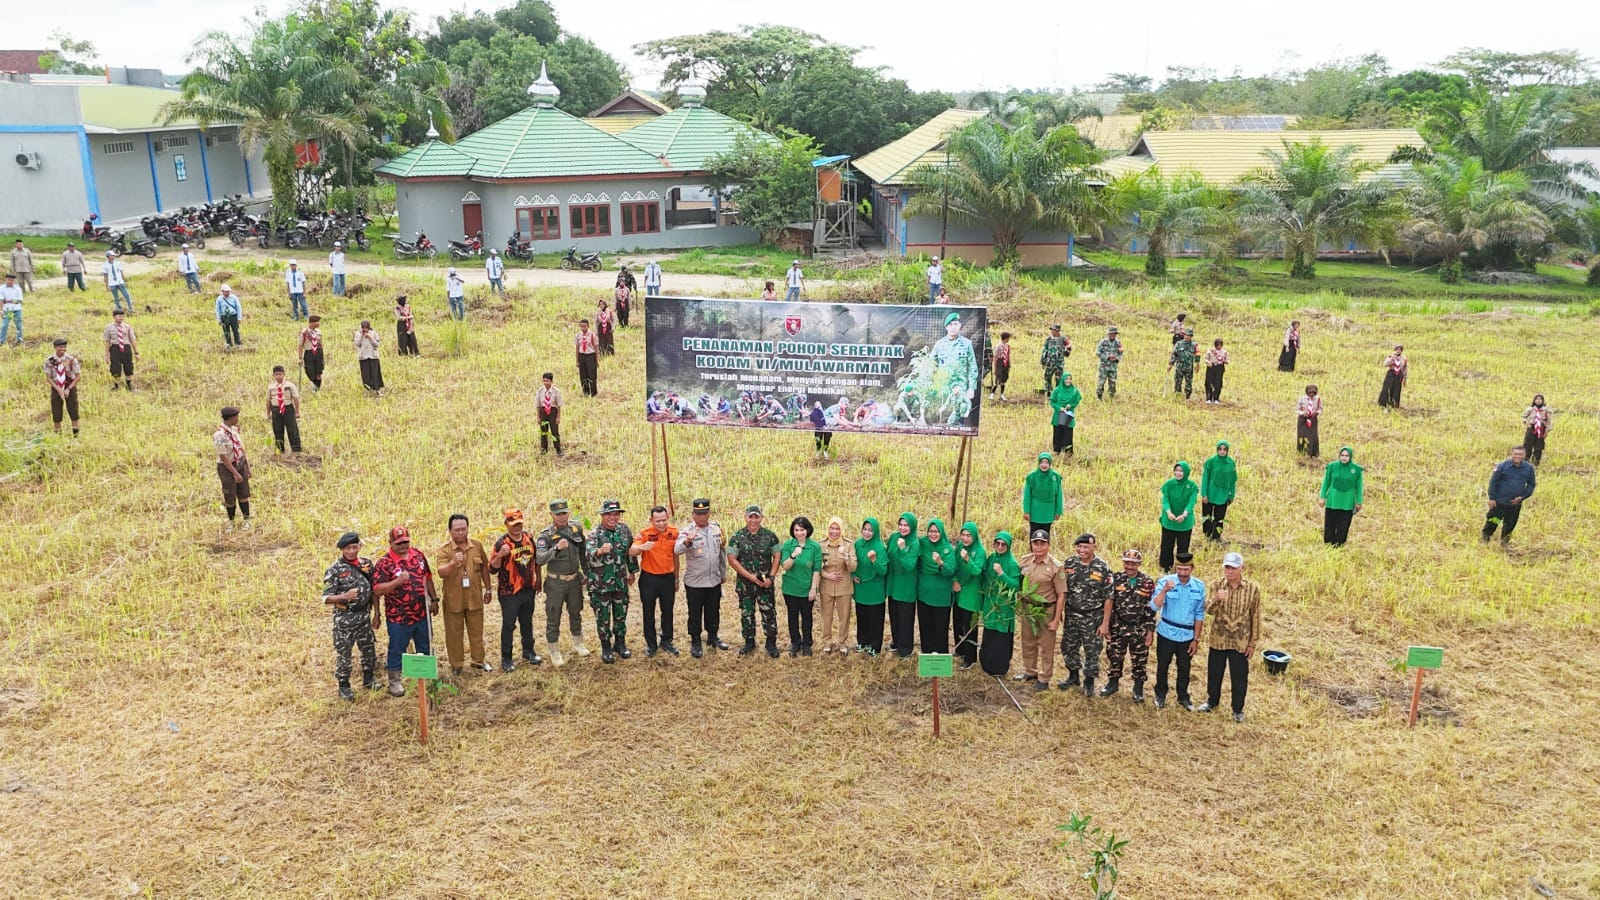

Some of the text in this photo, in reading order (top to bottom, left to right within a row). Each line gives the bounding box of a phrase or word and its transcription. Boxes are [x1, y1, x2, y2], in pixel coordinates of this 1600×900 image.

[683, 337, 904, 358] PENANAMAN POHON SERENTAK
[696, 355, 890, 375] KODAM VI/MULAWARMAN
